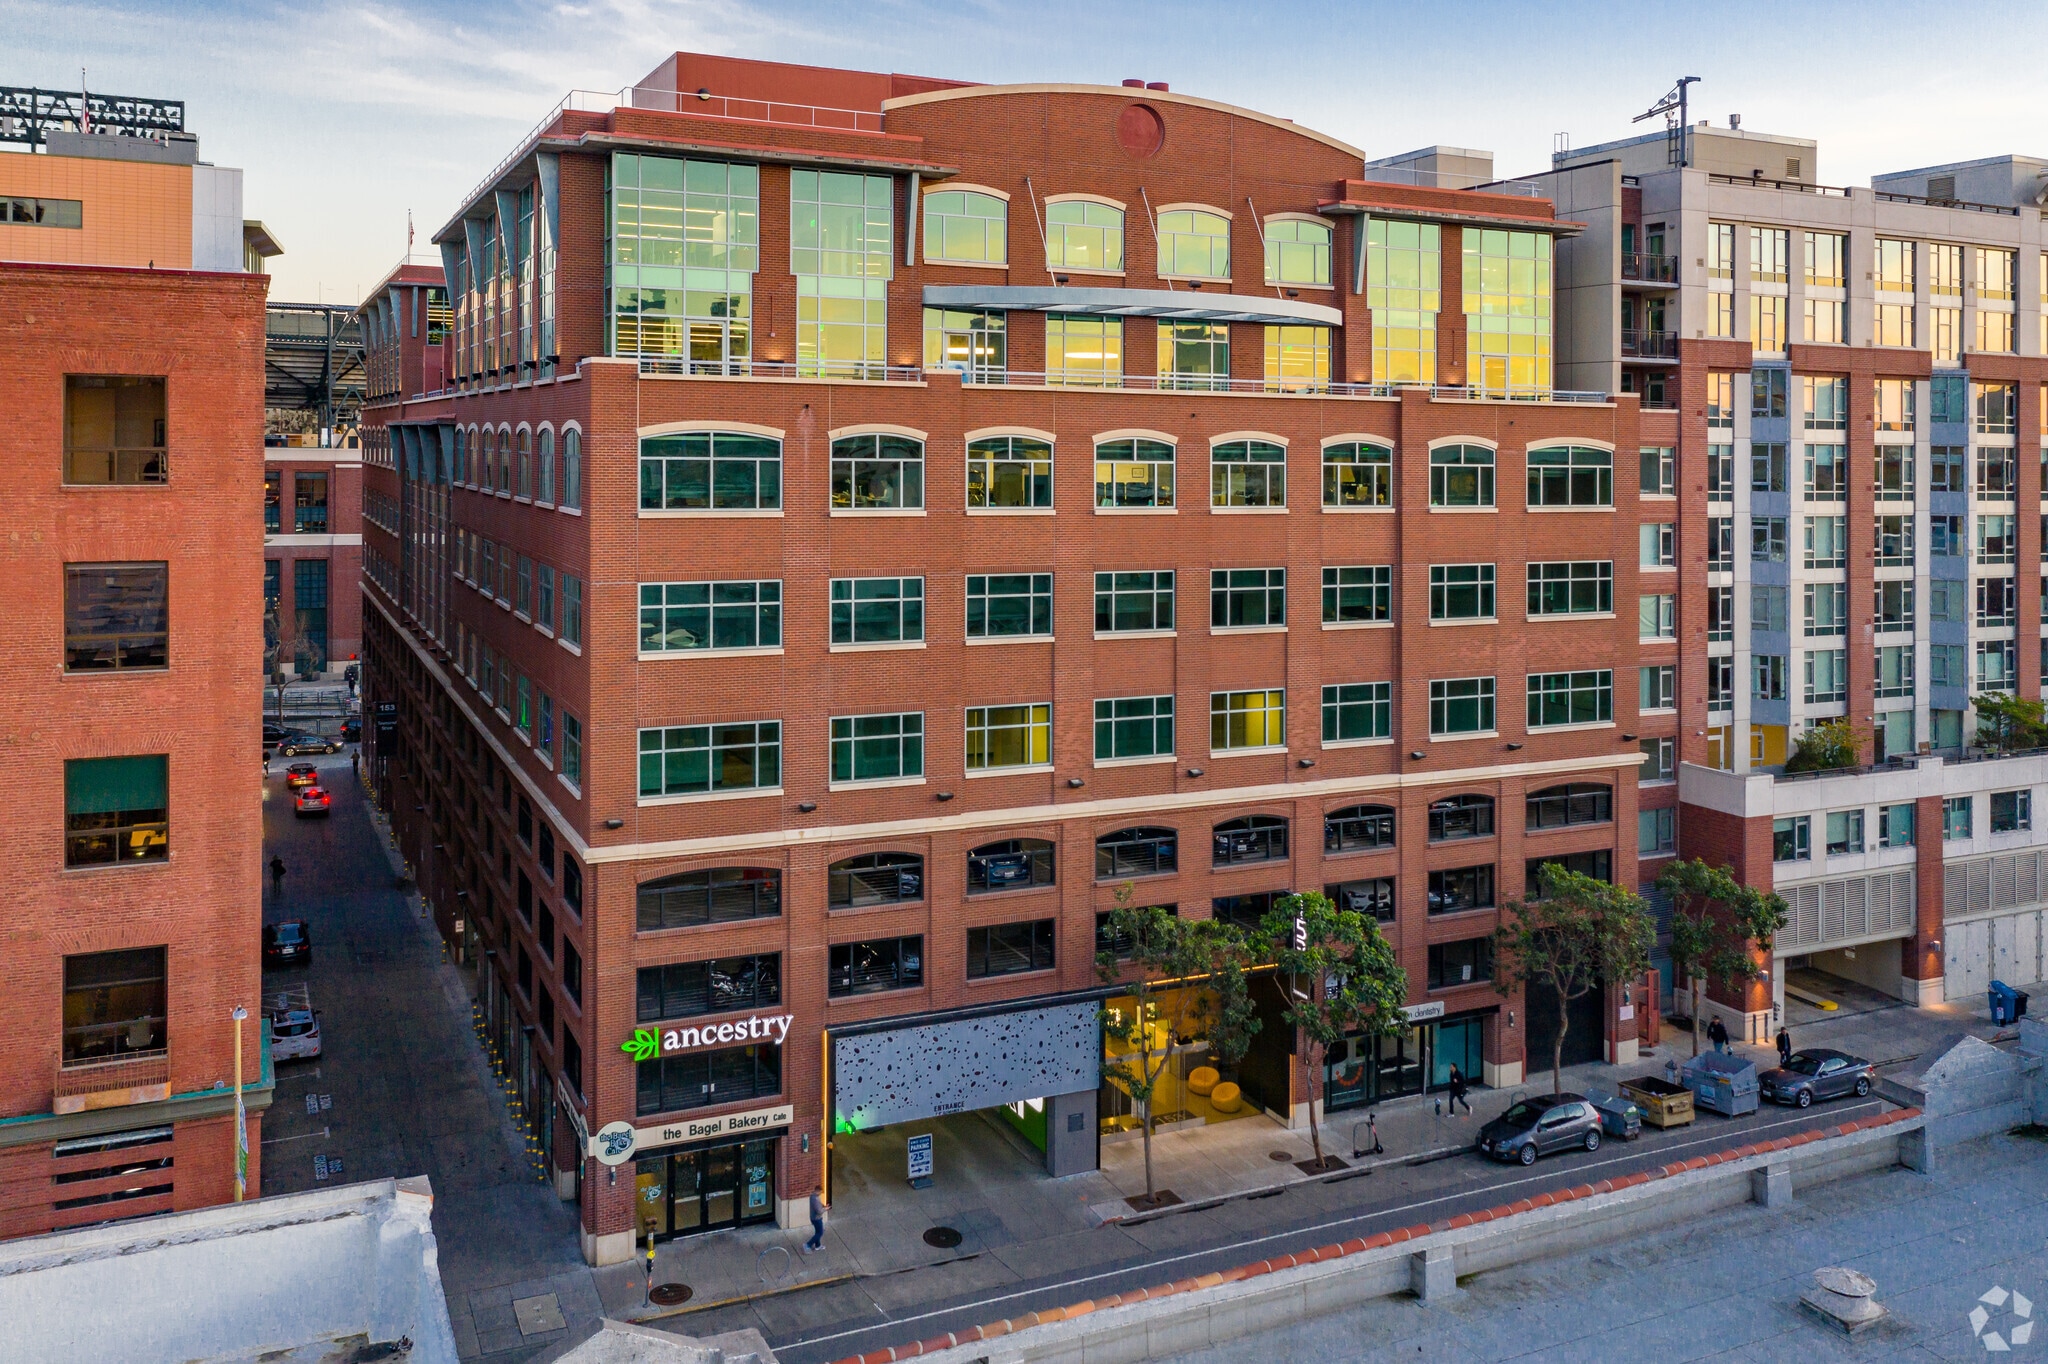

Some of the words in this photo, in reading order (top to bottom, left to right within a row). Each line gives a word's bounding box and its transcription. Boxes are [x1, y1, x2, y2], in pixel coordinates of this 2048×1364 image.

[1414, 1007, 1441, 1018] dentistry
[663, 1014, 794, 1051] ancestry
[933, 1101, 965, 1112] ENTRANCE
[663, 1129, 682, 1140] the
[689, 1121, 722, 1136] Bagel
[729, 1115, 768, 1130] Bakery
[773, 1112, 787, 1121] Cafe
[600, 1133, 611, 1142] the
[910, 1142, 930, 1151] PARKING
